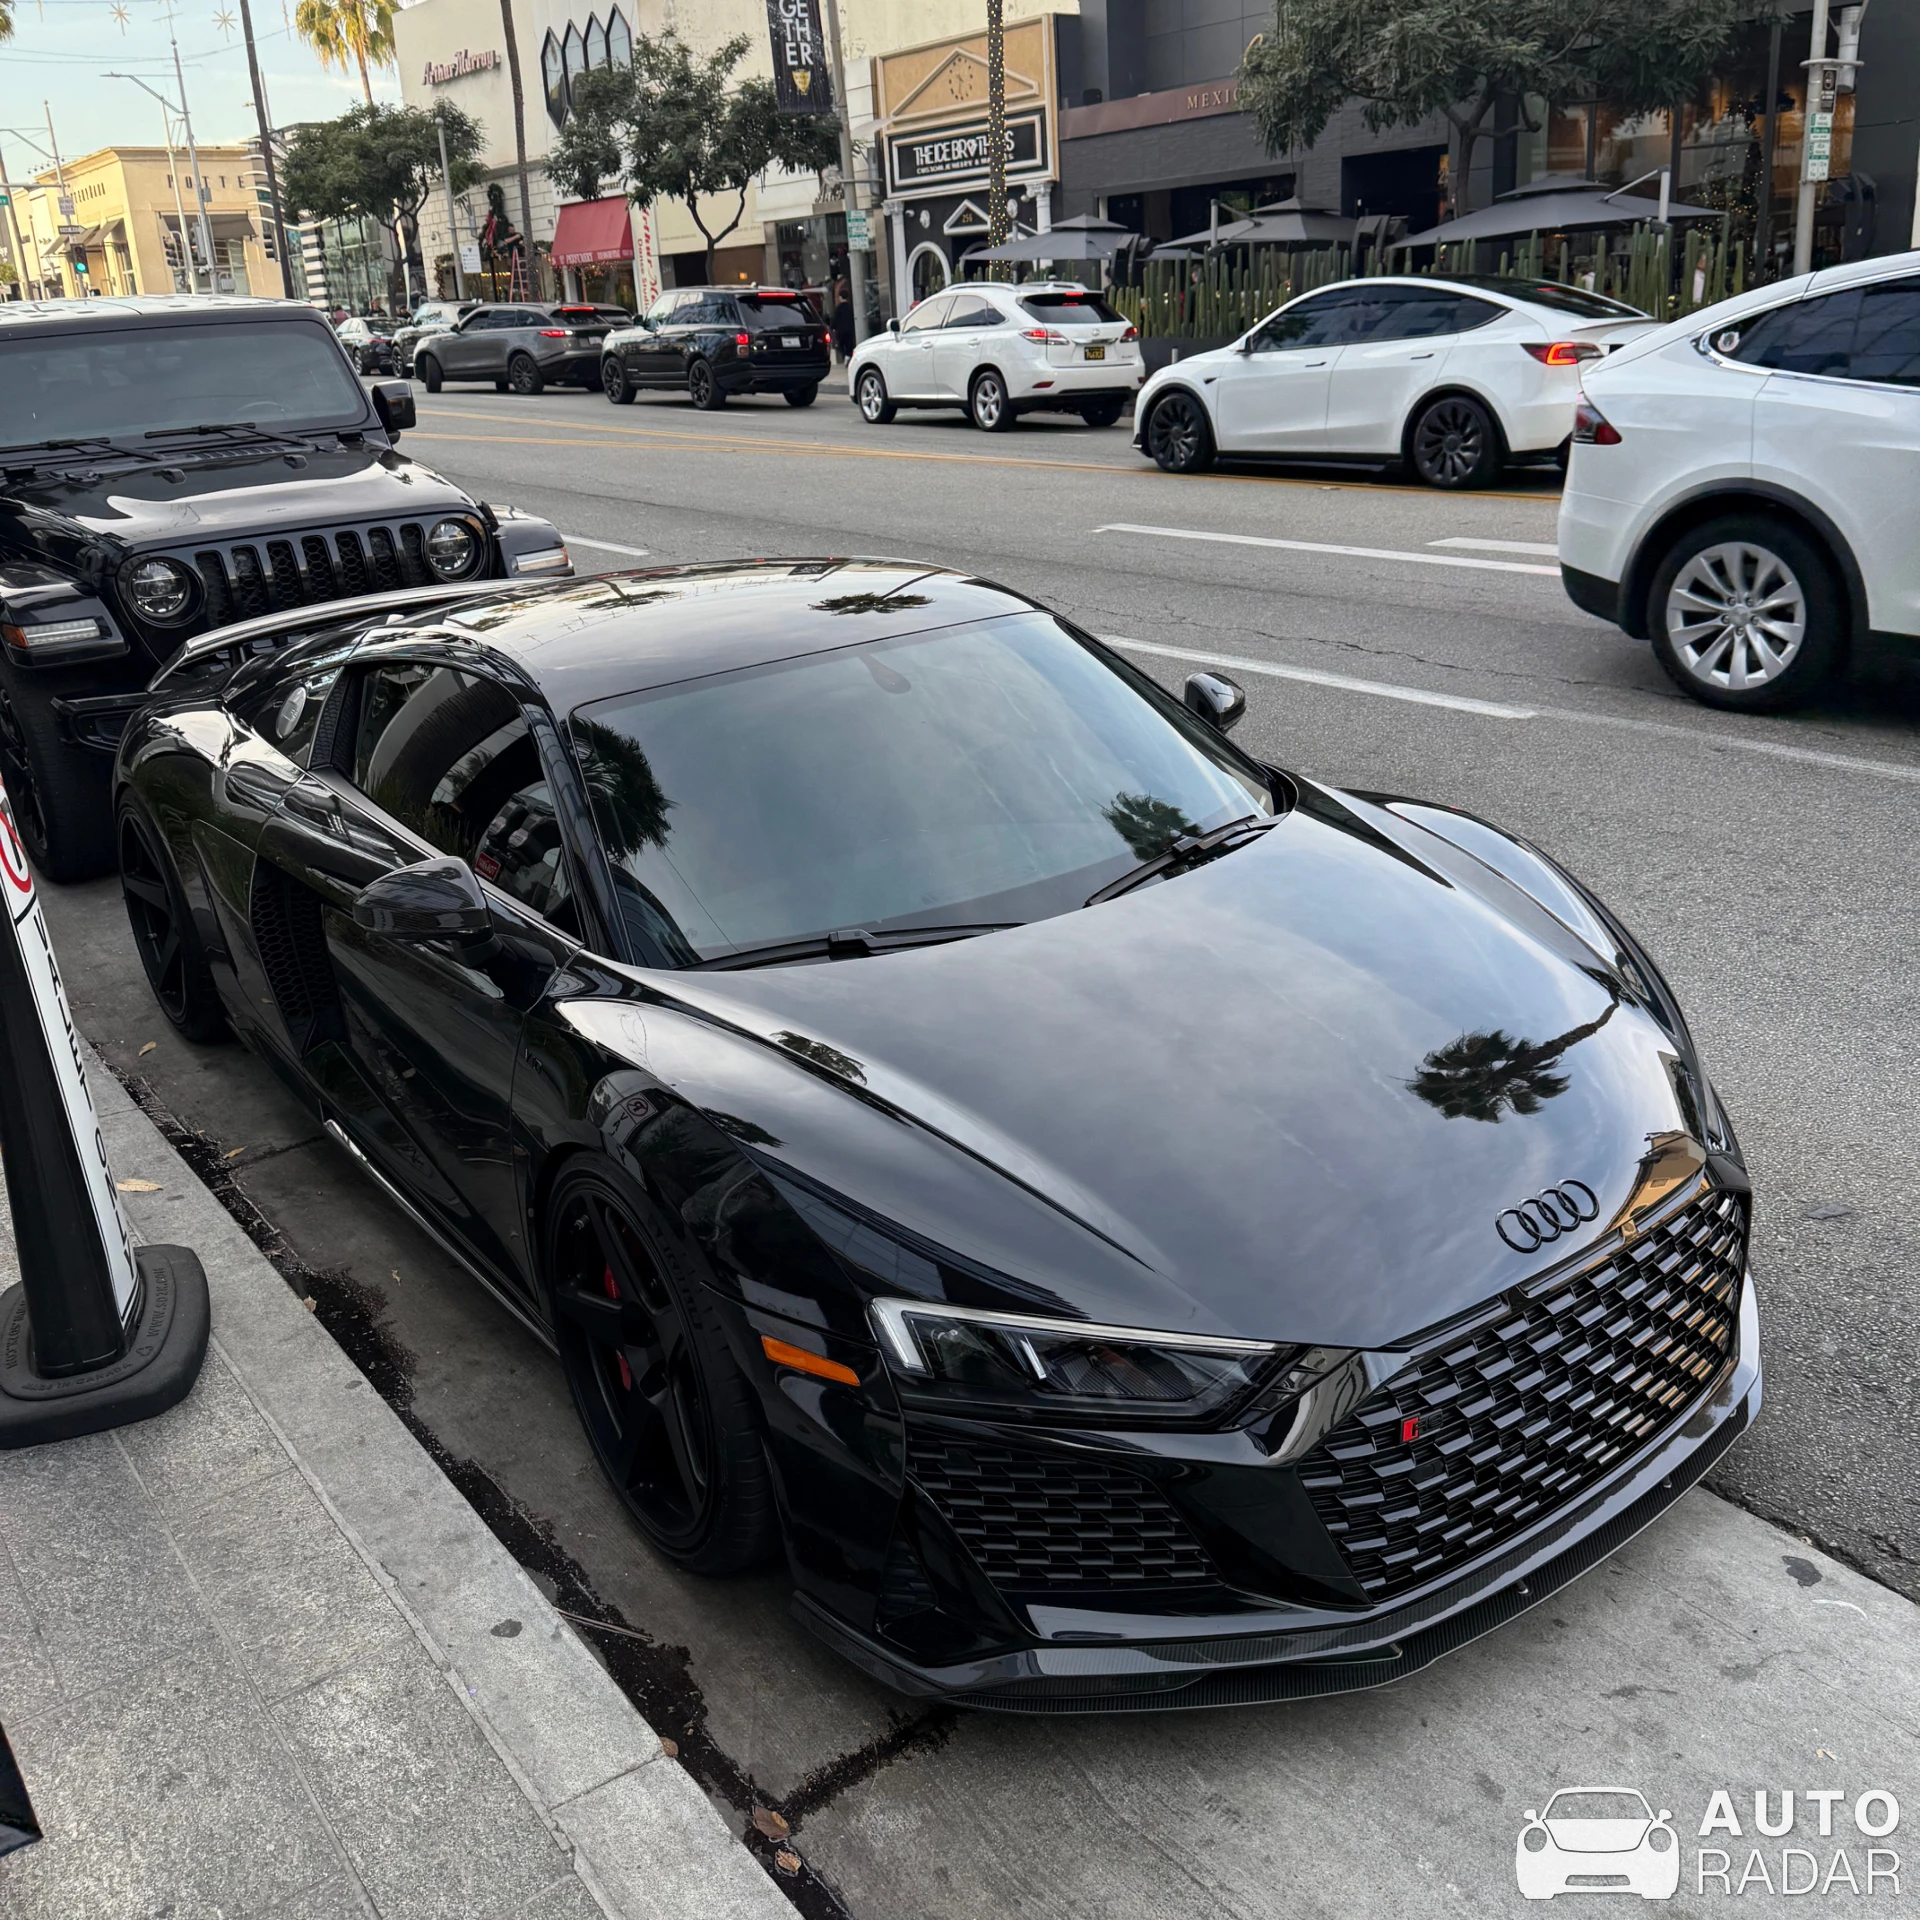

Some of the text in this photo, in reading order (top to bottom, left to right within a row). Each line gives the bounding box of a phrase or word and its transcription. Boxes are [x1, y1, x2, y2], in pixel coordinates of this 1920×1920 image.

[779, 0, 808, 18] GE
[782, 18, 811, 42] TH
[785, 42, 814, 66] ER
[421, 48, 496, 86] Arthur Murray
[32, 909, 138, 1281] VALET ONLY
